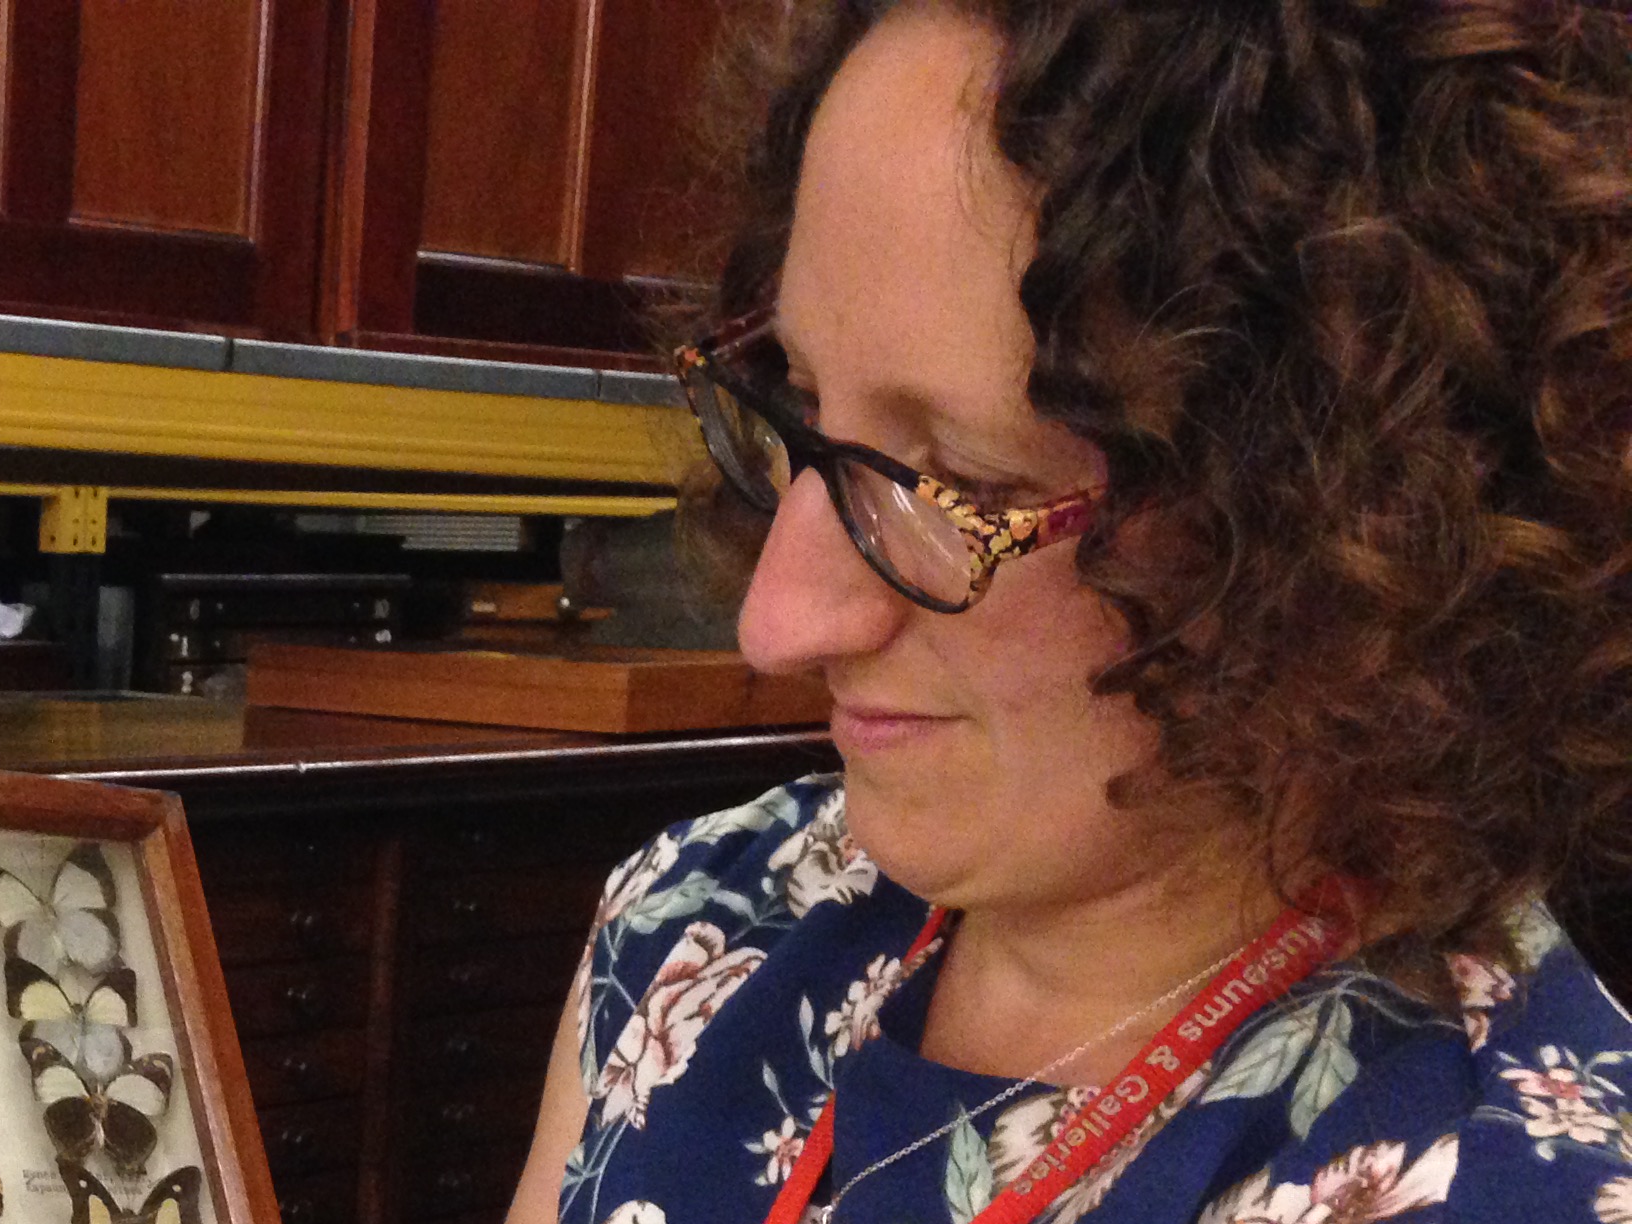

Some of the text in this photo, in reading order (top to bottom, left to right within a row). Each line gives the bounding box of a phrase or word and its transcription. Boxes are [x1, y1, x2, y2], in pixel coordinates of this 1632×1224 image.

[1011, 916, 1325, 1196] Museums & Galleries
